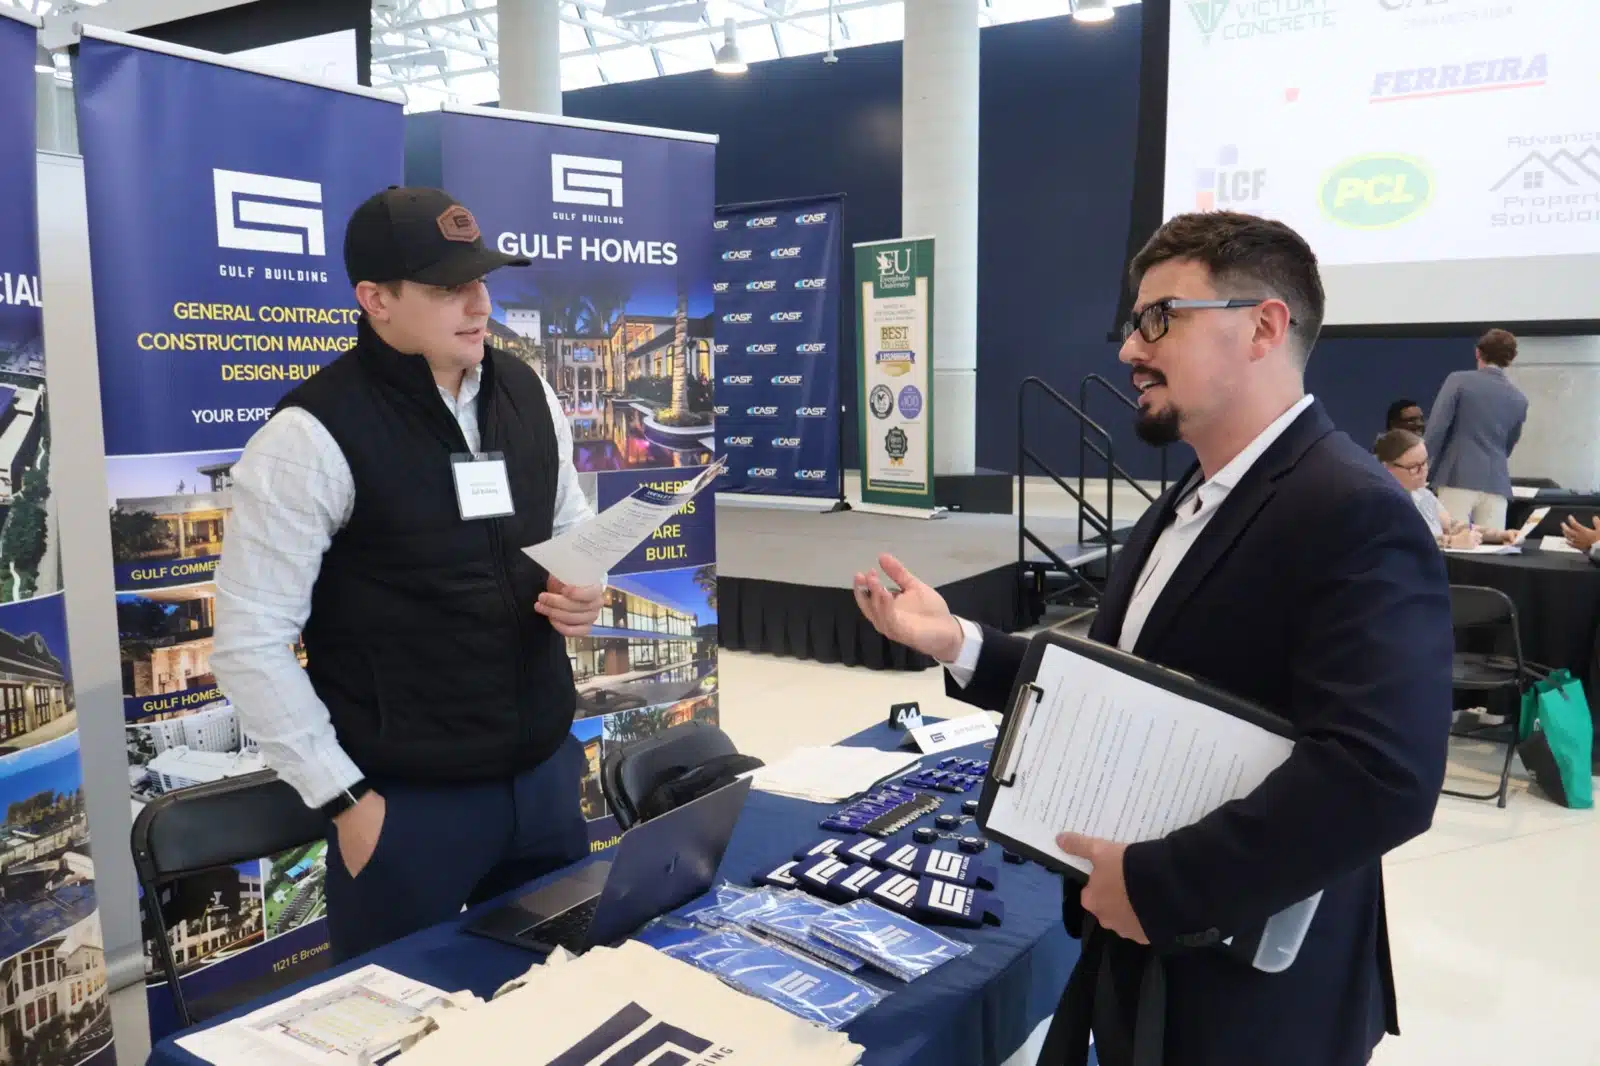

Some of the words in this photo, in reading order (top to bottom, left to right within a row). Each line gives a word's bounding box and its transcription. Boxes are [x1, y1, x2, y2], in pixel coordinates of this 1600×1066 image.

[1222, 11, 1337, 41] CONCRETE
[1371, 53, 1549, 96] FERREIRA
[1216, 168, 1266, 203] LCF
[1333, 173, 1417, 209] PCL
[553, 212, 576, 221] GULF
[582, 214, 624, 224] BUILDING
[752, 217, 777, 226] CASF
[802, 213, 827, 223] CASF
[497, 231, 572, 260] GULF
[581, 238, 678, 265] HOMES
[777, 247, 801, 257] CASF
[727, 251, 752, 260] CASF
[878, 248, 912, 276] EU
[219, 264, 254, 279] GULF
[265, 267, 328, 283] BUILDING
[752, 281, 777, 290] CASF
[802, 279, 827, 288] CASF
[174, 301, 254, 322] GENERAL
[259, 306, 362, 325] CONTRACTO
[728, 313, 752, 322] CASF
[777, 312, 802, 321] CASF
[881, 327, 909, 340] BEST
[137, 332, 283, 351] CONSTRUCTION
[752, 344, 777, 353] CASF
[802, 343, 826, 352] CASF
[729, 376, 753, 384] CASF
[777, 375, 802, 384] CASF
[191, 409, 234, 423] YOUR
[237, 407, 275, 422] EXPE
[754, 407, 778, 415] CASF
[802, 407, 827, 416] CASF
[730, 437, 753, 445] CASF
[778, 438, 801, 447] CASF
[752, 468, 777, 477] CASF
[801, 470, 827, 479] CASF
[652, 524, 681, 540] ARE
[646, 544, 688, 561] BUILT.
[131, 567, 168, 580] GULF
[143, 697, 179, 712] GULF
[181, 688, 222, 706] HOMES
[896, 706, 918, 723] 44
[272, 958, 290, 972] 1121
[291, 953, 299, 964] E
